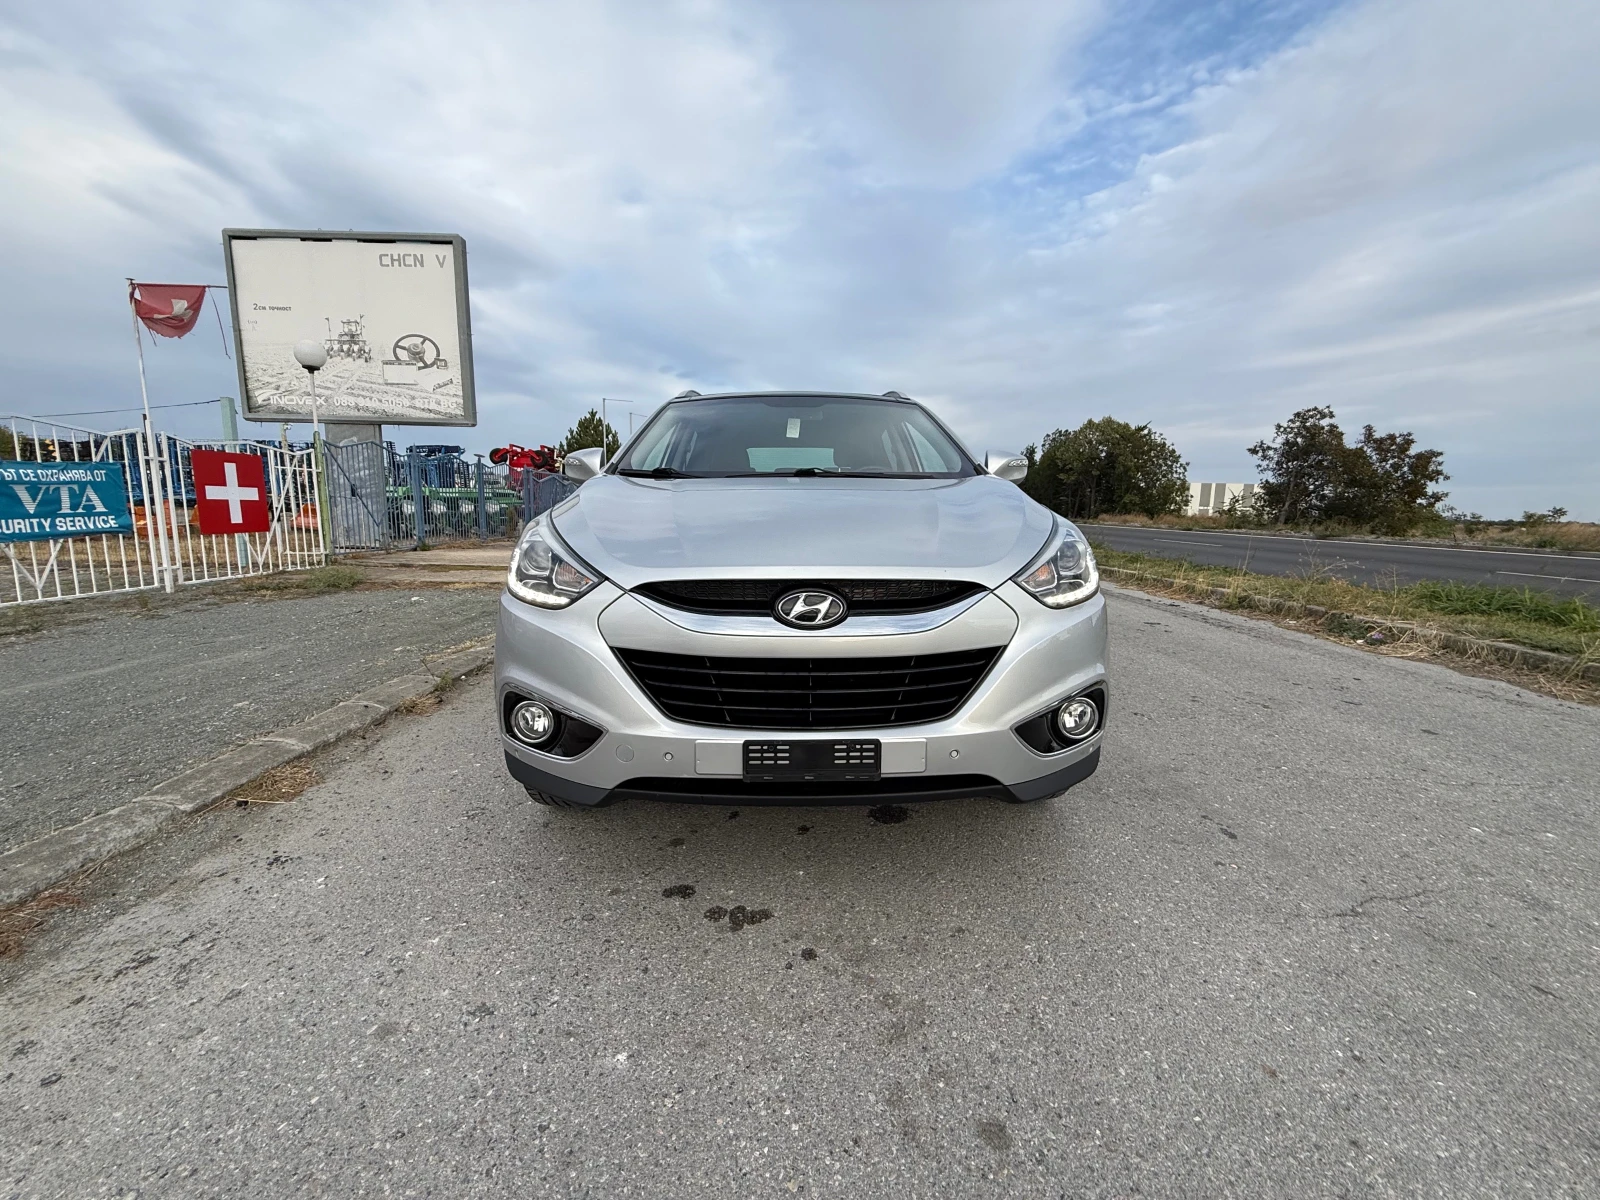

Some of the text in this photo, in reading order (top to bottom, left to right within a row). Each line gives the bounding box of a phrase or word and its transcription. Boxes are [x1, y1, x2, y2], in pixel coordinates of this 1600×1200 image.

[0, 468, 107, 482] ЪТ СЕ ОХРАНЯВА ОТ
[8, 483, 109, 514] VTA
[0, 515, 119, 534] URITY SERVICE
